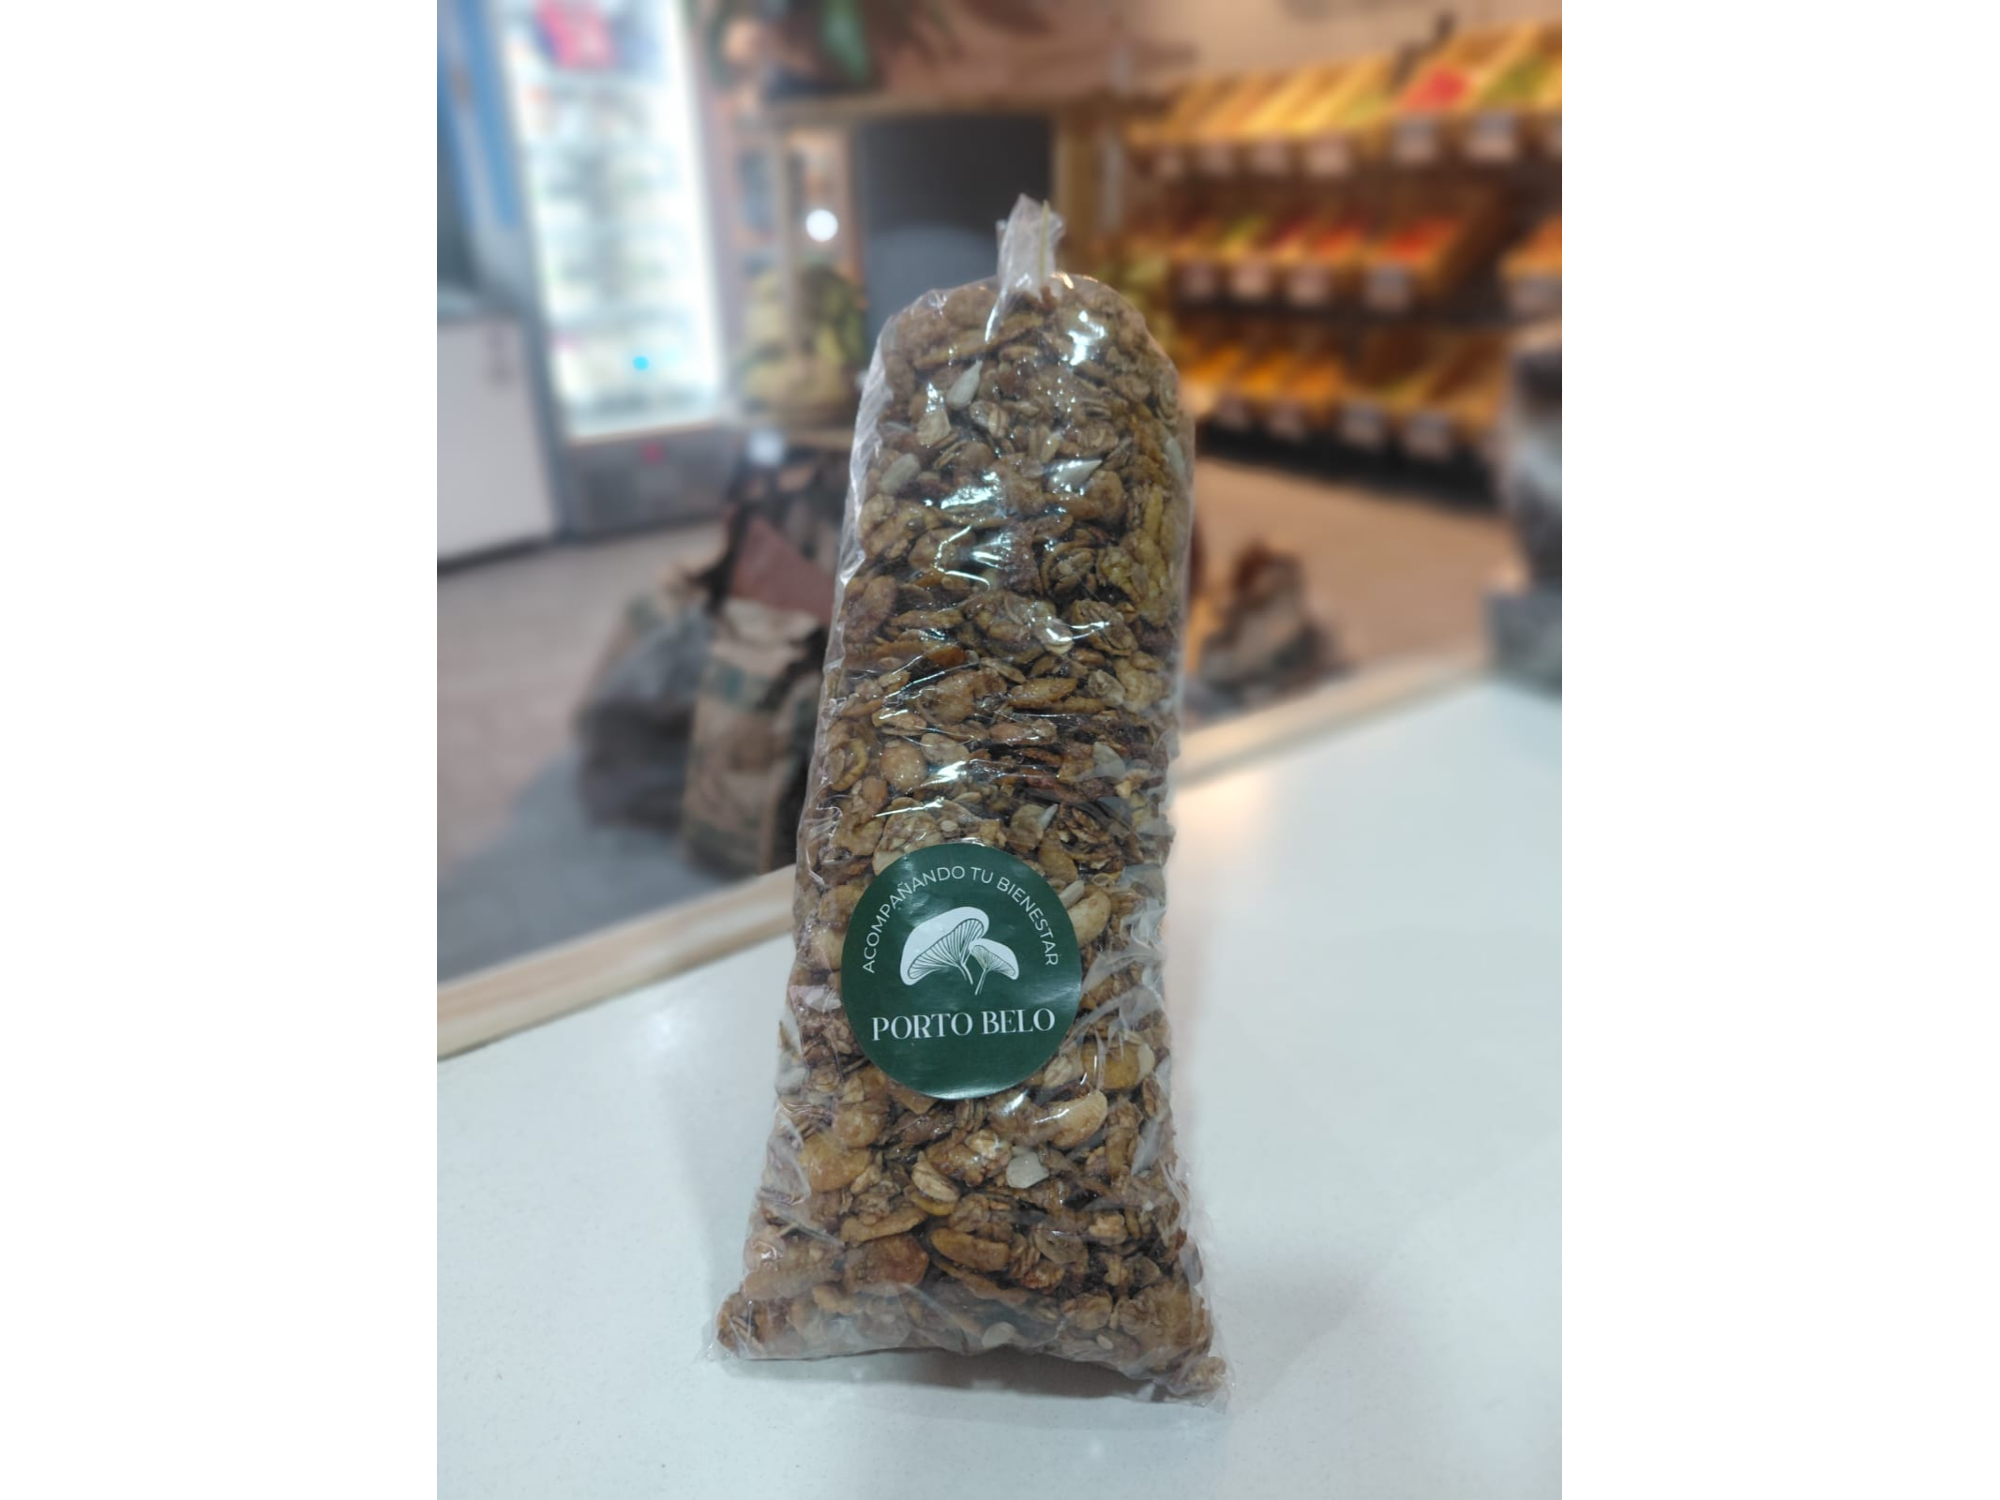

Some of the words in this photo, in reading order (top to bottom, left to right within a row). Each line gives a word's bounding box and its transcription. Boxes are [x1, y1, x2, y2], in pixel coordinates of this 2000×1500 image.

[862, 865, 966, 974] ACOMPAÑANDO
[970, 866, 994, 884] TU
[996, 876, 1059, 966] BIENESTAR
[871, 1012, 973, 1042] PORTO
[981, 1008, 1056, 1036] BELO
